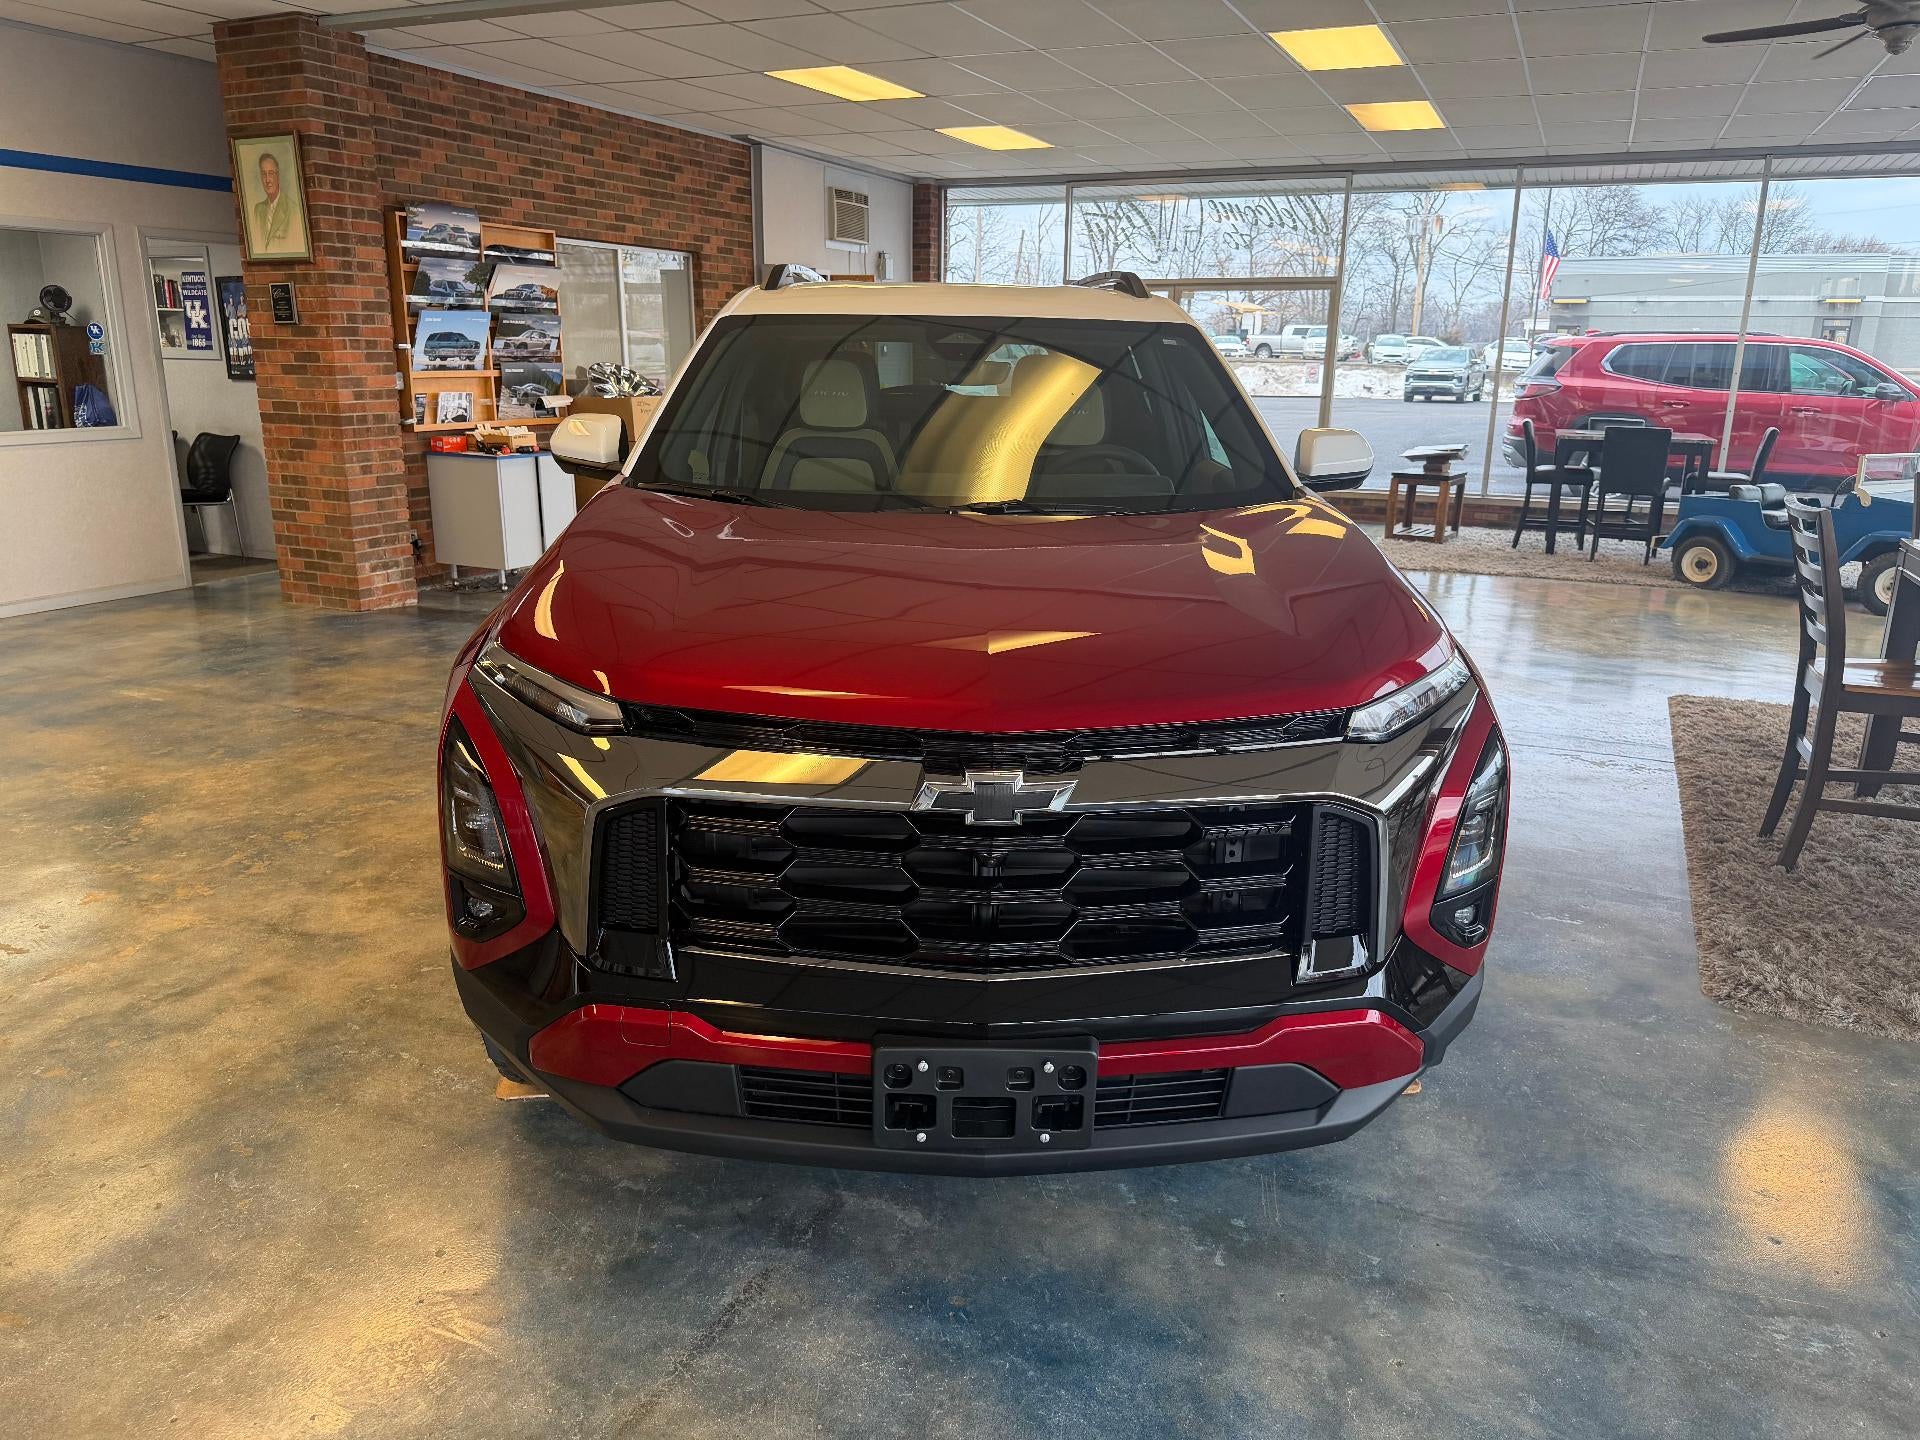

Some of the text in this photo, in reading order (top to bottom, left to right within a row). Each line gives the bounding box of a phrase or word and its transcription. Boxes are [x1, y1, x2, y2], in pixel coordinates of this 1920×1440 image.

[182, 274, 206, 283] KENTUCKY
[184, 300, 208, 329] UK
[192, 338, 206, 348] 1865
